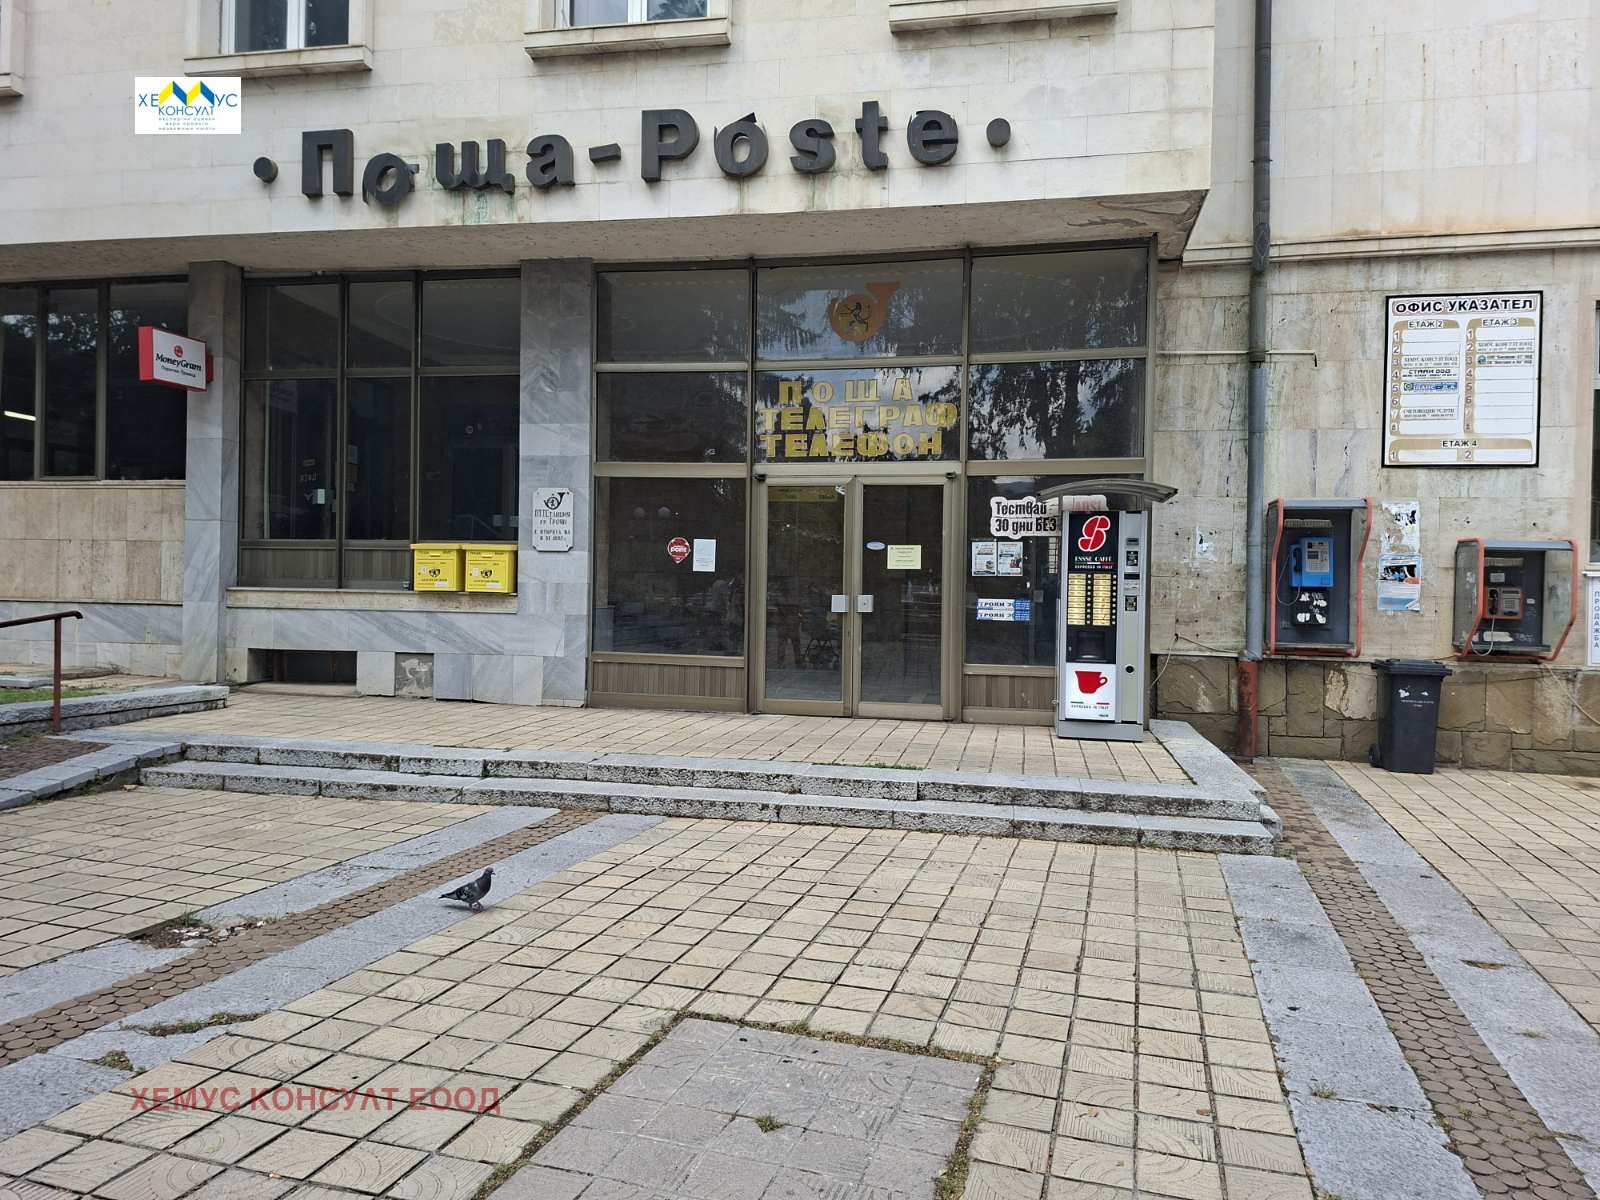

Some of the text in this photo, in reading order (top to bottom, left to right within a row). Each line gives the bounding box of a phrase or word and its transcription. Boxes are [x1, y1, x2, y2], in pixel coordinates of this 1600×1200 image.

[1395, 299, 1533, 313] ОФИС УКАЗАТЕЛ
[1408, 320, 1443, 329] ЕТАЖ 2
[1482, 318, 1518, 327] ЕТАЖ 3
[155, 353, 202, 372] MoneyGram
[778, 378, 914, 405] ПОЩА
[757, 402, 958, 432] ТЕЛЕГРАФ
[759, 430, 943, 458] ТЕЛЕФОН
[1442, 440, 1469, 448] ЕТАЖ
[995, 500, 1047, 517] Тествай
[995, 517, 1057, 535] 30 дни БЕЗ
